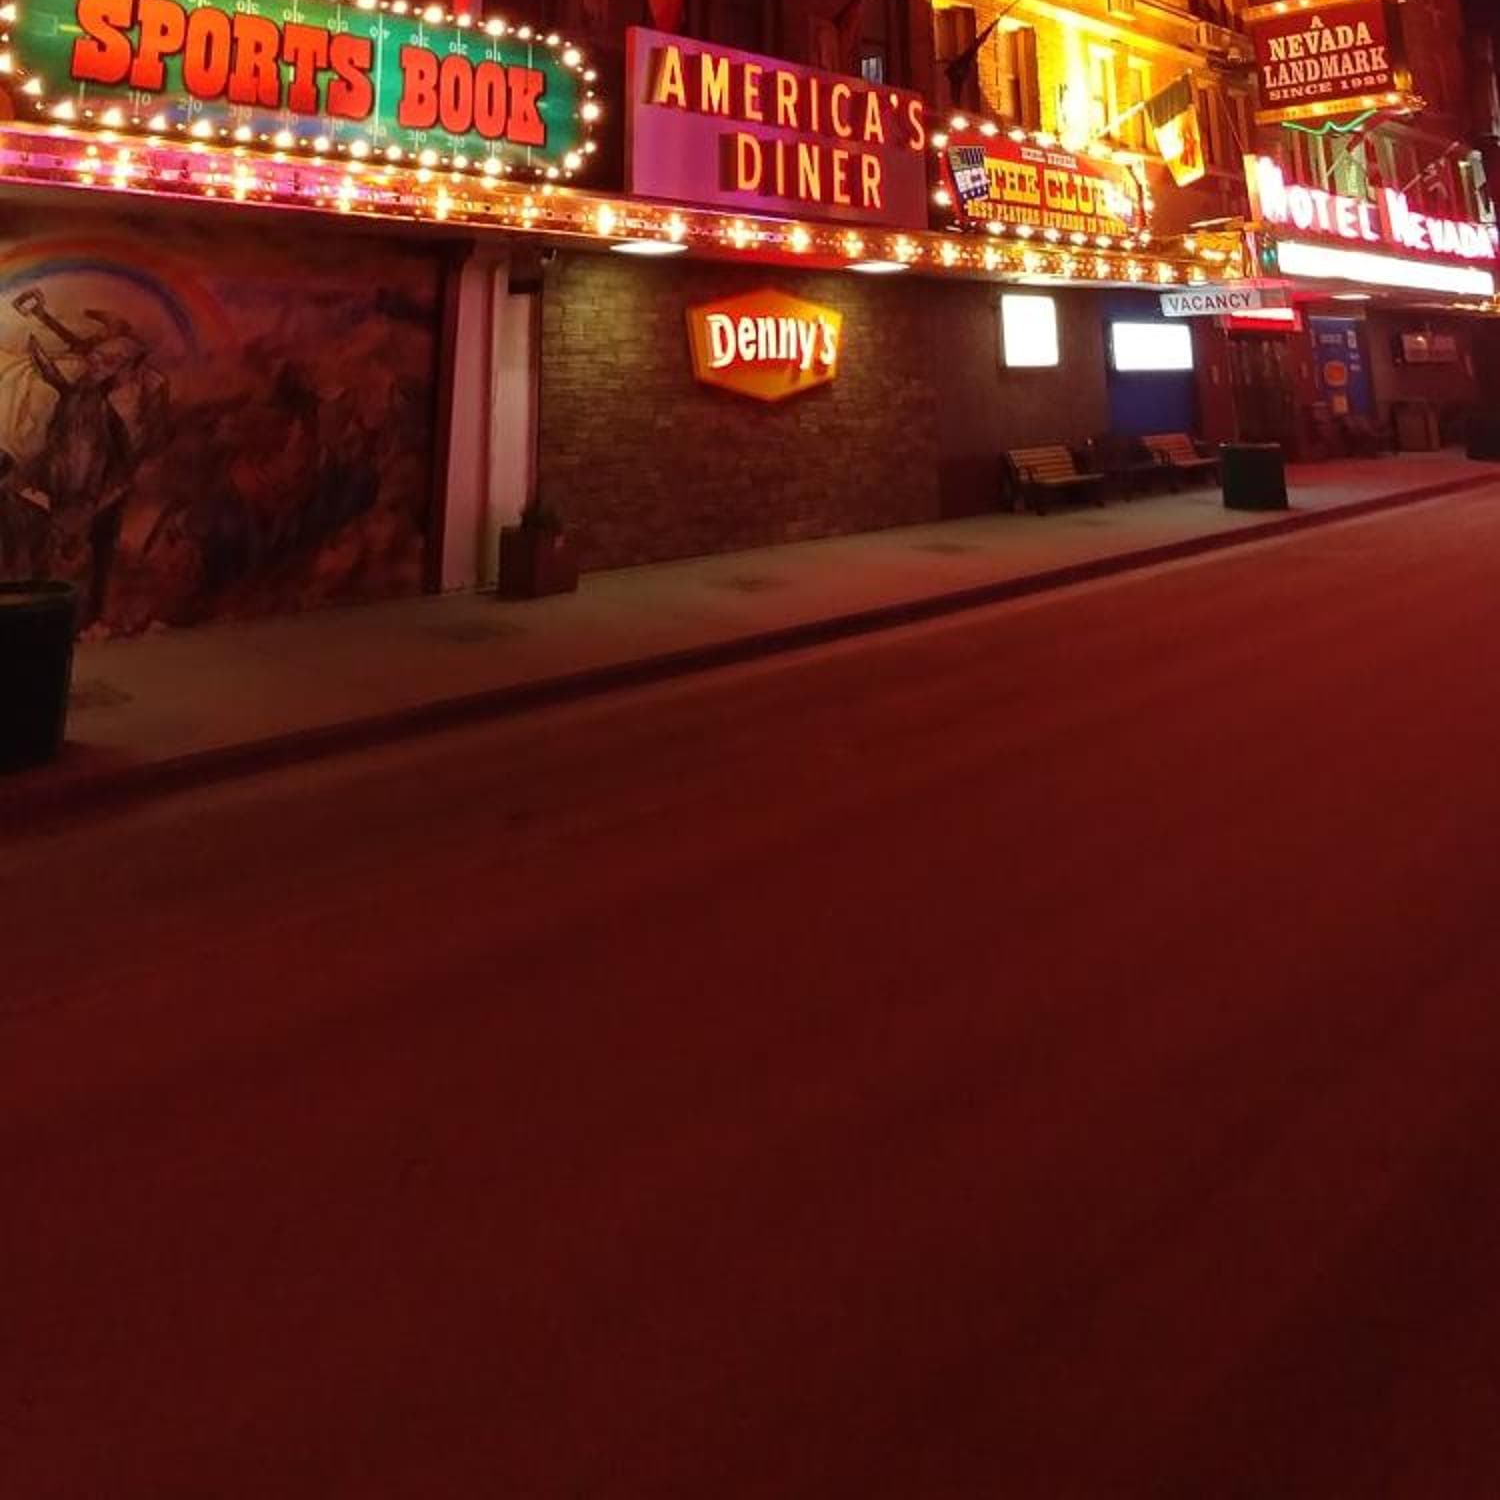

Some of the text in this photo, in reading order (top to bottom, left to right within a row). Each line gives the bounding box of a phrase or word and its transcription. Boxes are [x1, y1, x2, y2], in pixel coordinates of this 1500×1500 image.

[1267, 21, 1374, 62] NEVADA
[1310, 15, 1324, 29] A
[1264, 46, 1389, 88] LANDMARK
[1268, 73, 1389, 100] SINCE 1929
[398, 45, 546, 146] BOOK
[655, 45, 926, 151] AMERICA'S
[737, 131, 881, 209] DINER
[984, 156, 1041, 205] THE
[1258, 156, 1380, 241] HOTEL
[1167, 292, 1253, 312] VACANCY
[705, 313, 837, 371] Denny's
